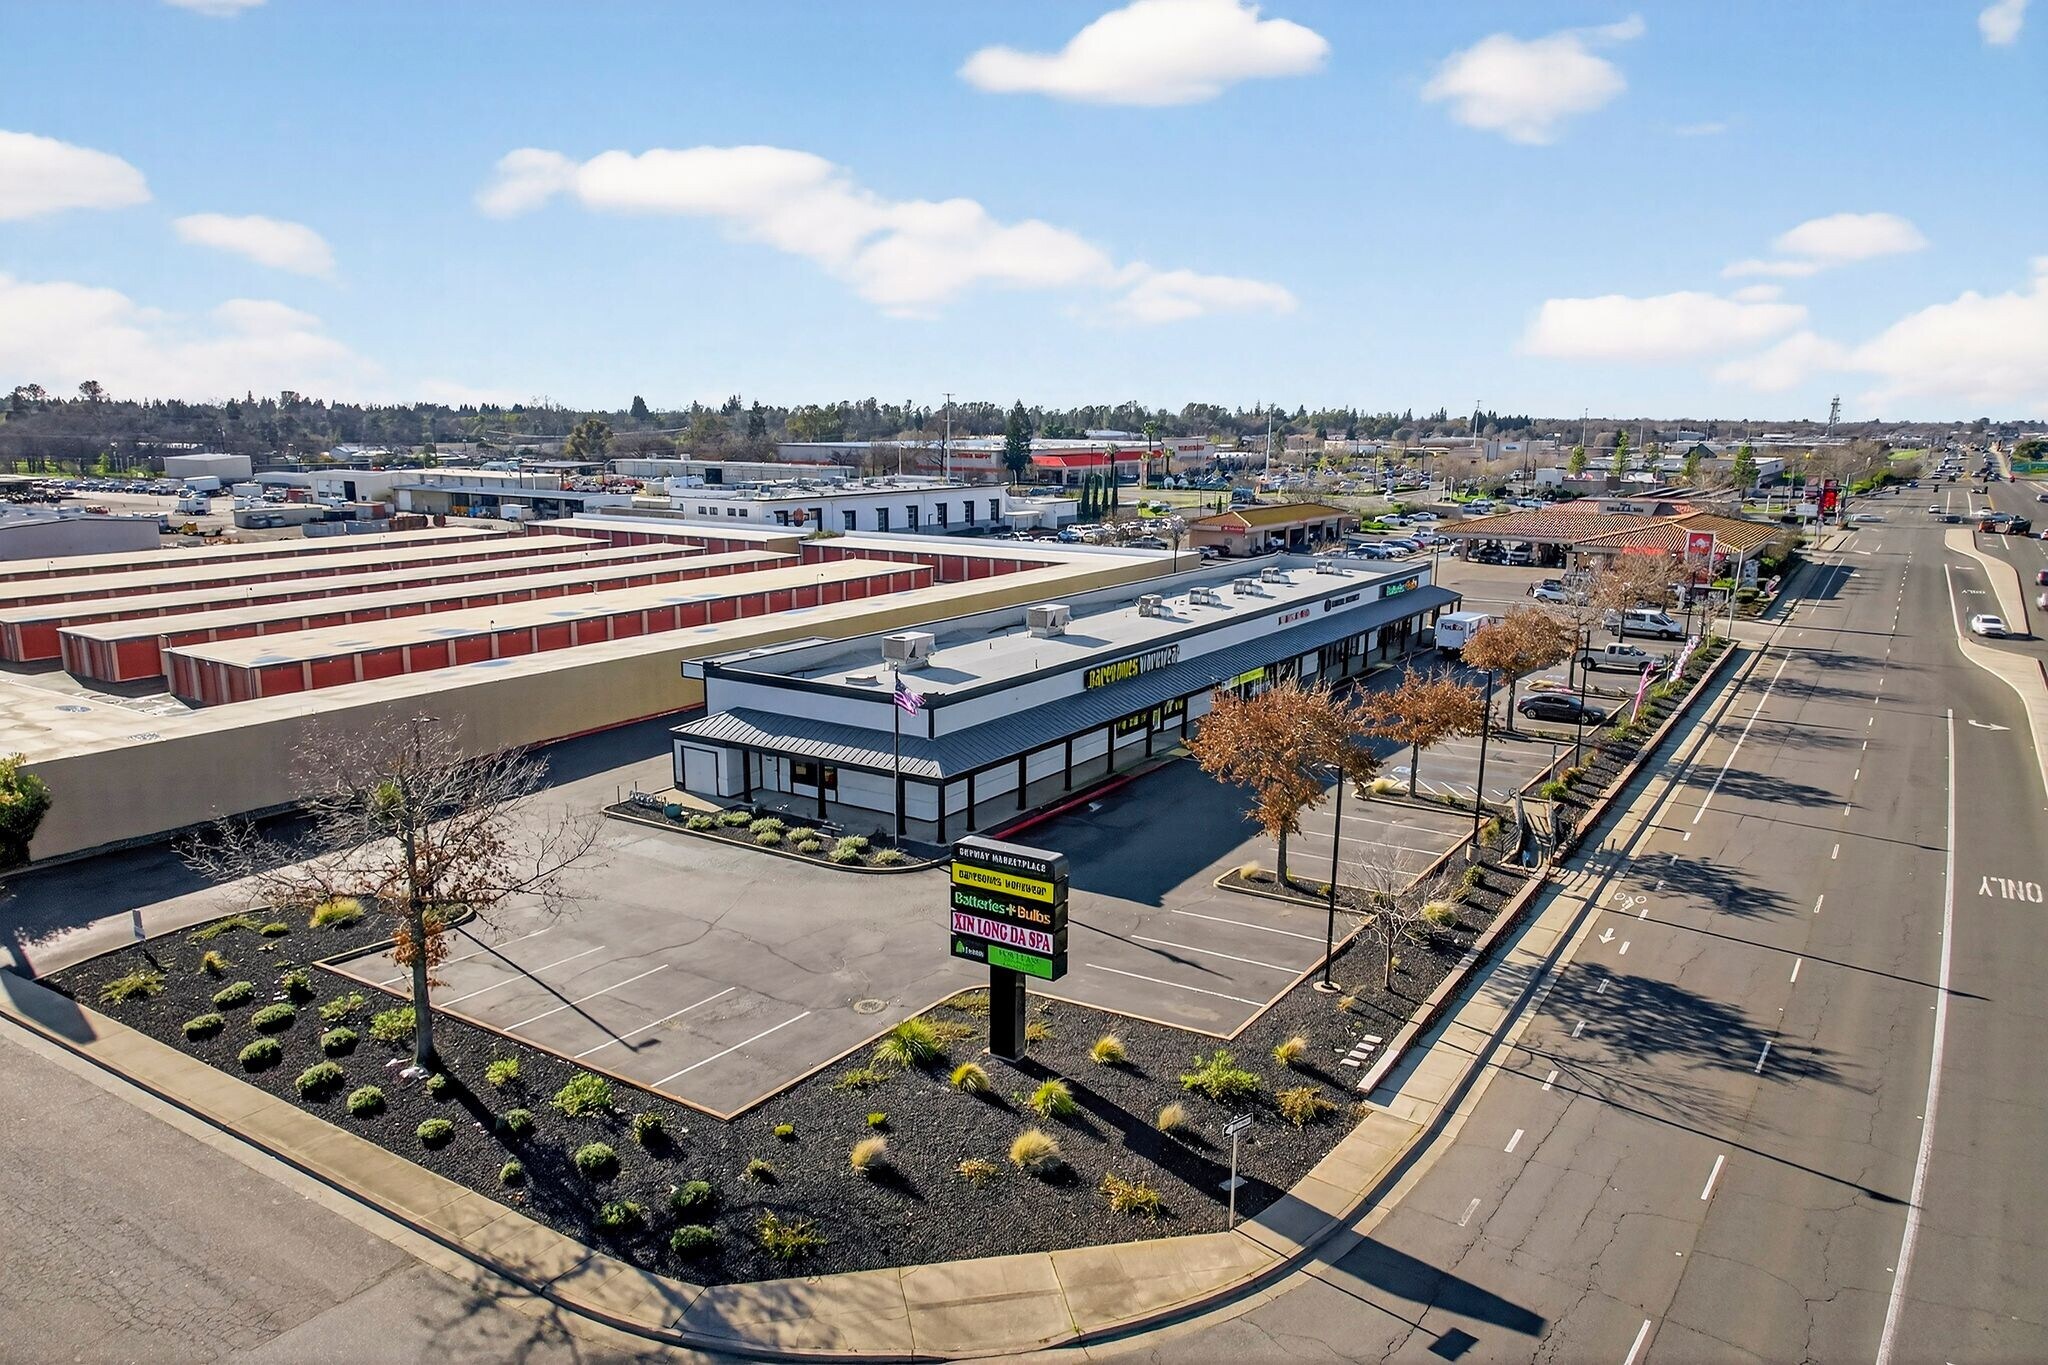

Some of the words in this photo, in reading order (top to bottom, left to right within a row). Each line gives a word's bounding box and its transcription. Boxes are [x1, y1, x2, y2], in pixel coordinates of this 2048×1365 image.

[1978, 875, 2043, 903] ONLY
[954, 913, 975, 933] XIN
[977, 918, 1008, 941] LONG
[1010, 926, 1026, 947] DA
[1029, 931, 1051, 952] SPA
